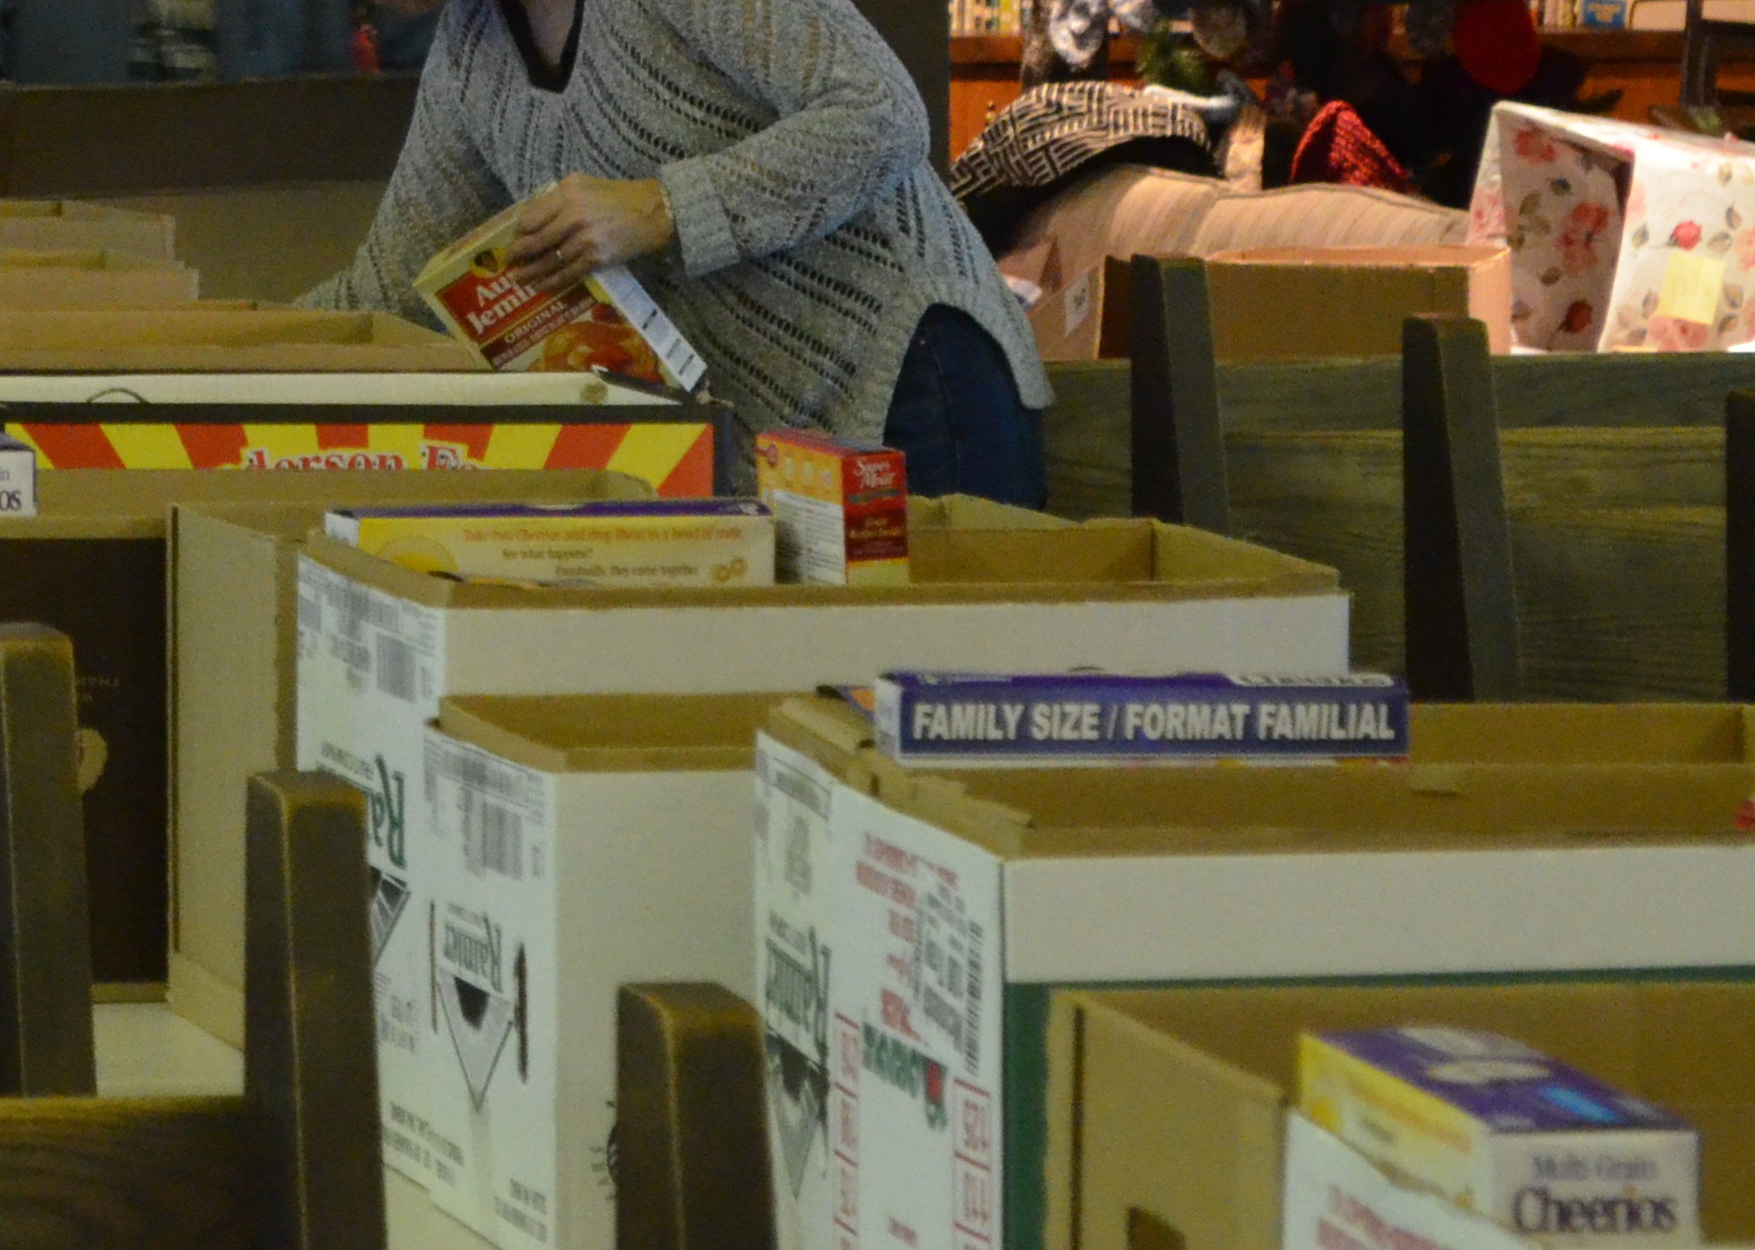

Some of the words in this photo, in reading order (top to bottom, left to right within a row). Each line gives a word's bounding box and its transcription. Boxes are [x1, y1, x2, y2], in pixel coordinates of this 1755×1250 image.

[504, 299, 568, 345] ORIGINAL
[912, 702, 1024, 740] FAMILY
[1031, 702, 1101, 740] SIZE
[1106, 702, 1120, 740] /
[1123, 702, 1250, 740] FORMAT
[1255, 701, 1396, 740] FAMILIAL
[1512, 1183, 1678, 1235] Cheerios
